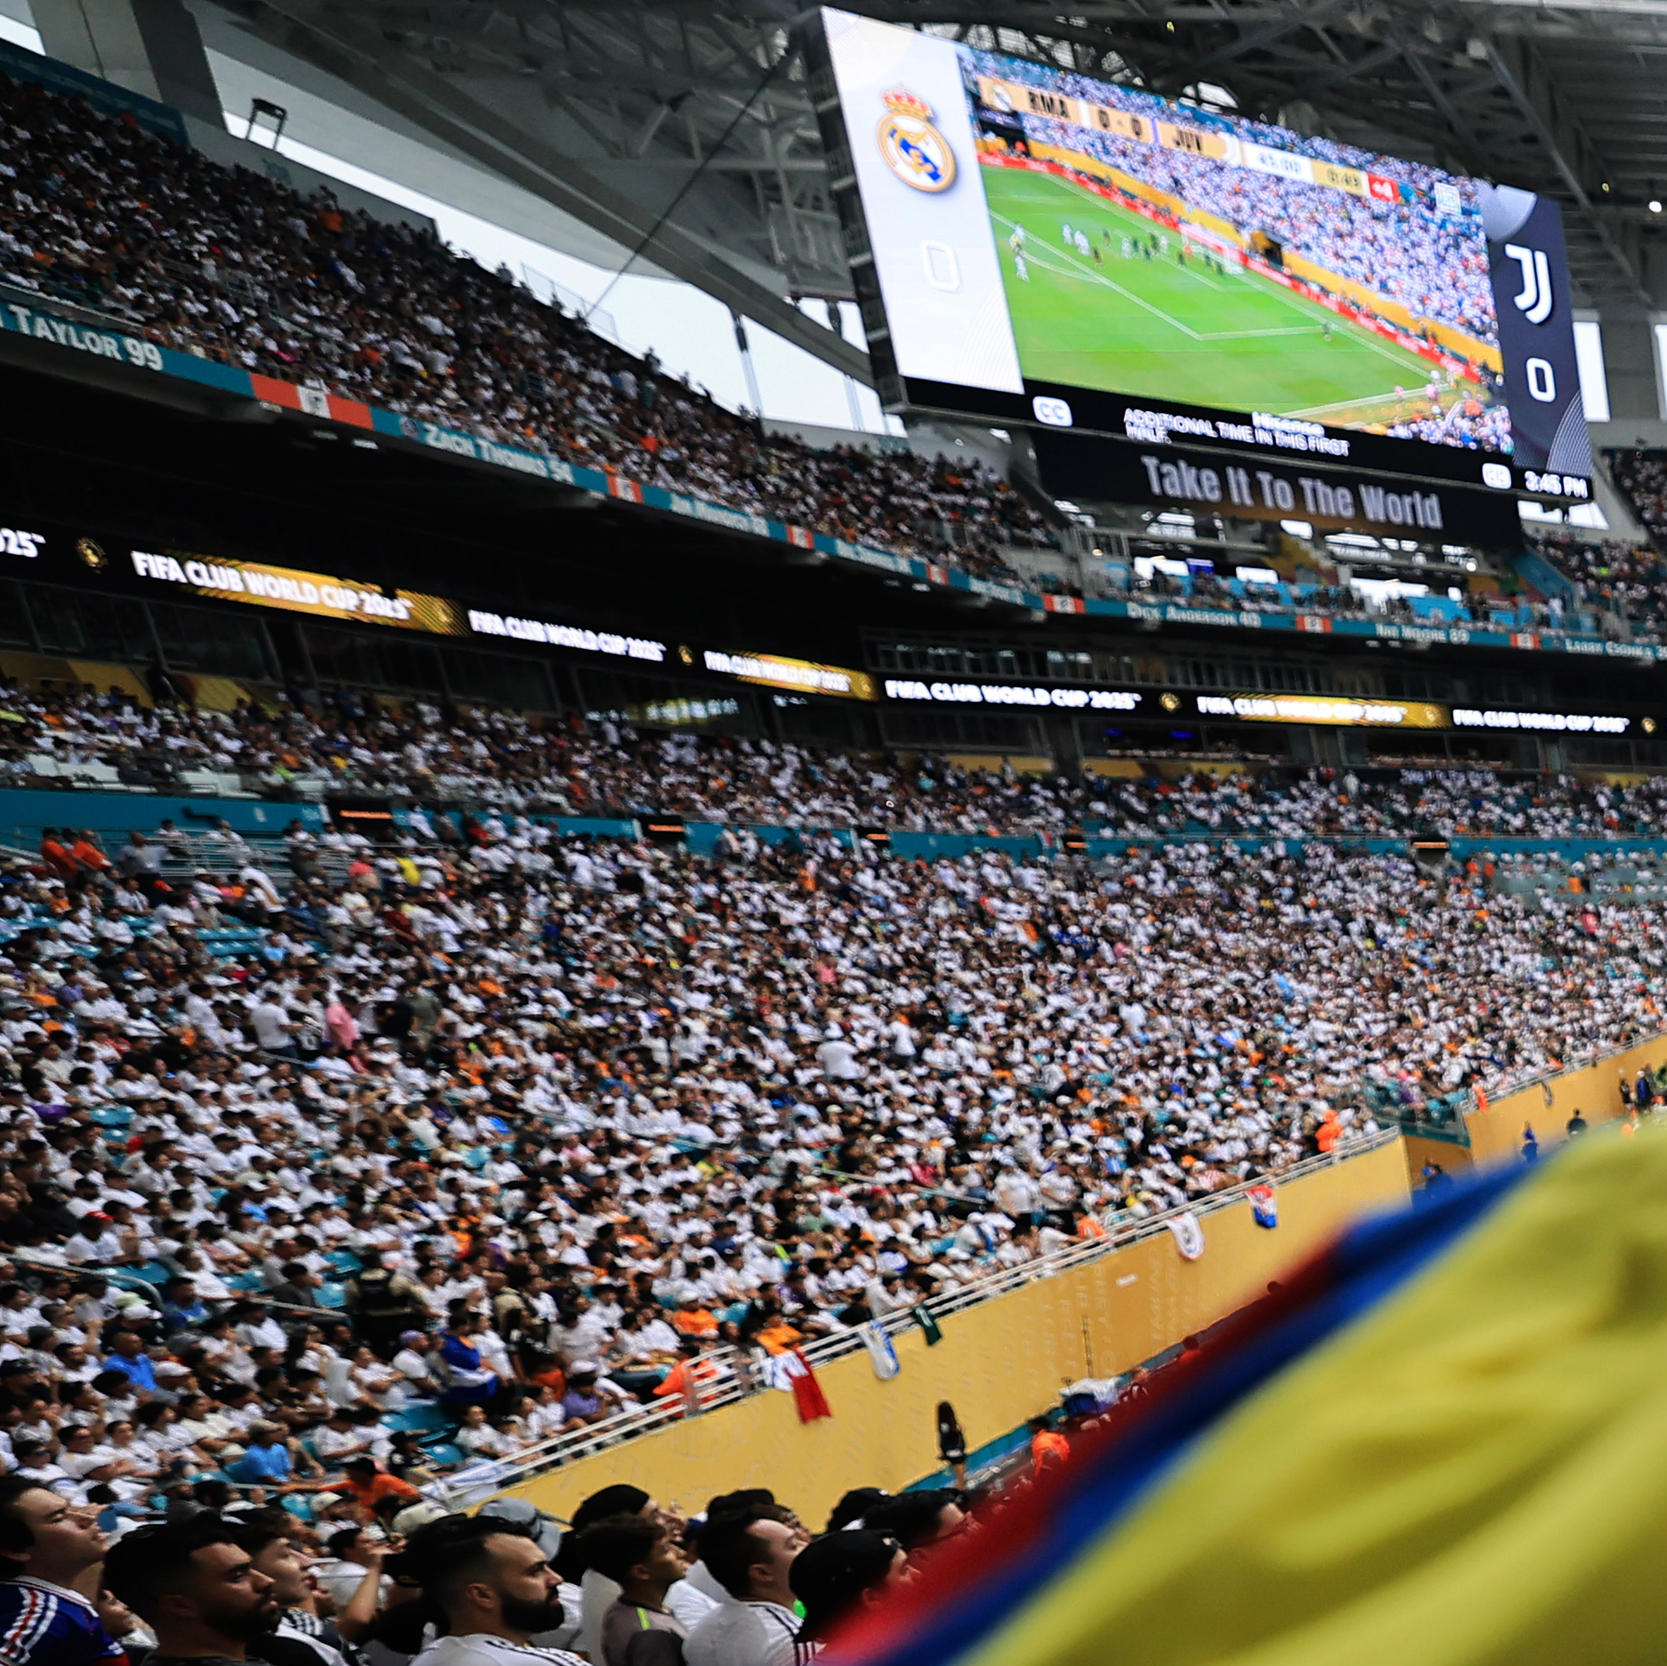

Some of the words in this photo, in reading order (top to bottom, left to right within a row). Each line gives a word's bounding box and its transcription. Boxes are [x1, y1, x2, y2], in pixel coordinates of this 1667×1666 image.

[9, 304, 123, 361] TAYLOR
[122, 337, 163, 371] 99
[1525, 357, 1557, 403] 0
[1216, 421, 1255, 444] TIME
[1254, 428, 1274, 446] IN
[1272, 430, 1309, 451] THIS
[1140, 455, 1223, 503] Take
[1226, 465, 1254, 508] It
[1256, 469, 1296, 512] To
[1298, 476, 1356, 518] The
[1358, 482, 1444, 530] World
[1562, 475, 1589, 498] PM
[130, 550, 189, 584] FIFA
[184, 559, 244, 592] CLUB
[241, 566, 319, 605] WORLD
[319, 584, 363, 612] CUP
[467, 609, 508, 637] FIFA
[505, 615, 549, 643] CLUB
[544, 622, 601, 651] WORLD
[597, 632, 630, 656] CUP
[885, 680, 933, 699] FIFA
[930, 682, 983, 702] CLUB
[981, 685, 1052, 706] WORLD
[1050, 688, 1090, 708] CUP
